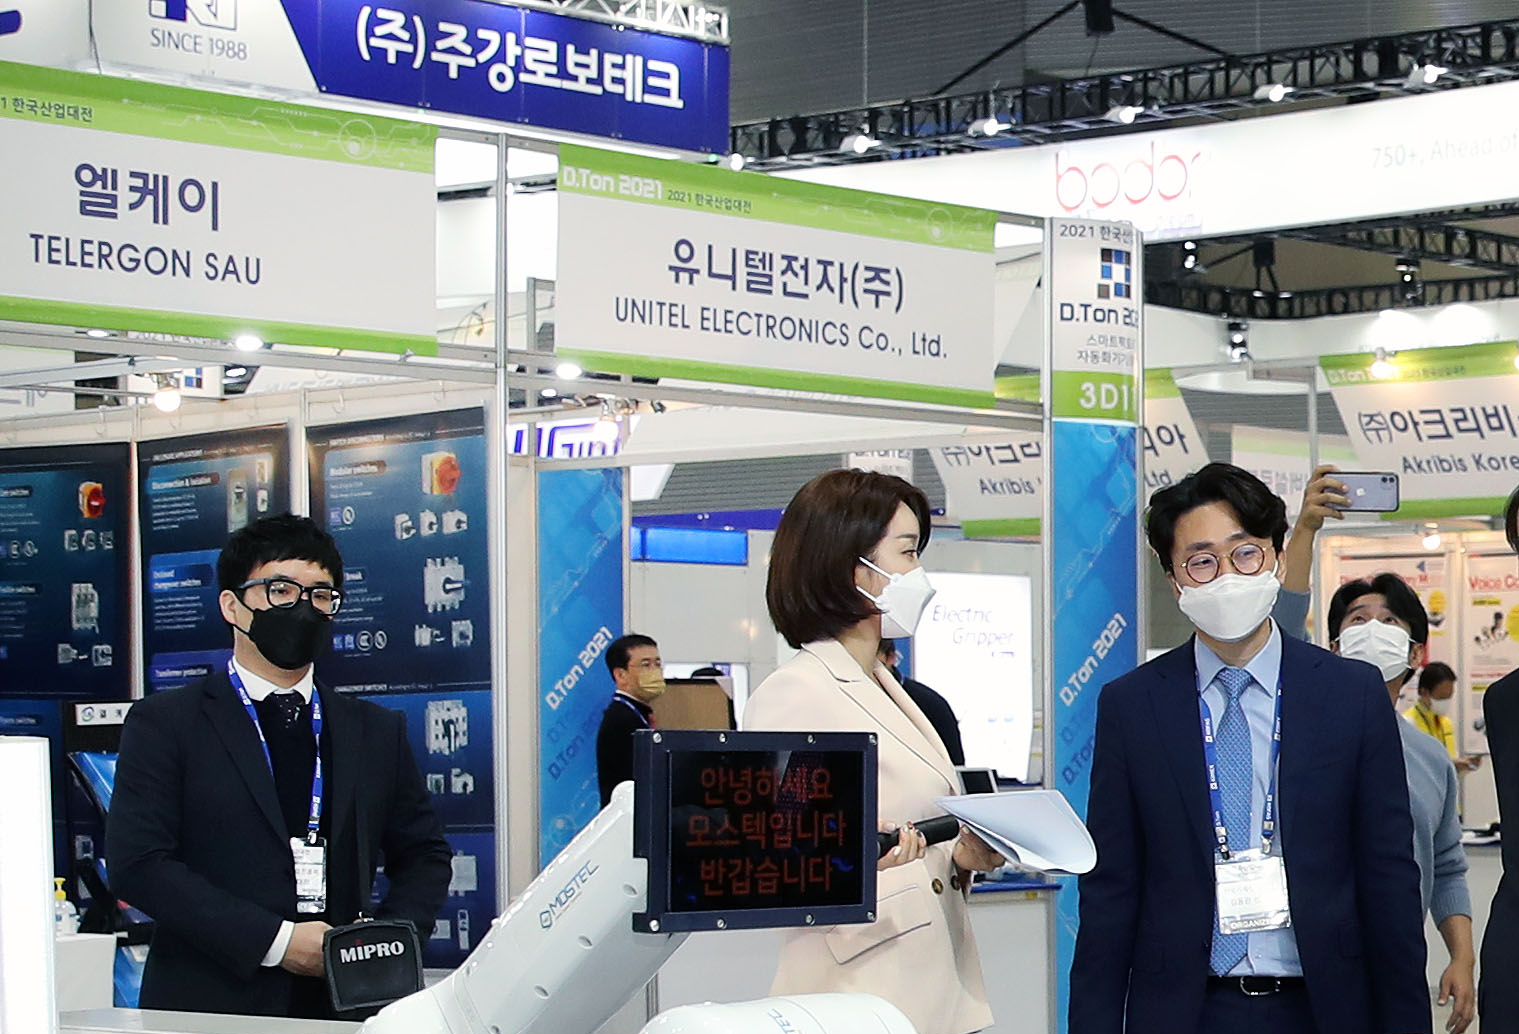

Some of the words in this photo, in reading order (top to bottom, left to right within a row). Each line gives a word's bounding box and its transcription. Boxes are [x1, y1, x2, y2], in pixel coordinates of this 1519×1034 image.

[150, 28, 203, 55] SINCE
[208, 37, 248, 61] 1988
[356, 5, 685, 110] (주)주강로보테크
[12, 100, 94, 123] 한국산업대전
[74, 162, 220, 232] 엘케이
[562, 167, 615, 194] D.Ton
[619, 177, 663, 200] 2021
[667, 188, 693, 204] 2021
[695, 192, 752, 214] 한국산업대전
[1060, 224, 1094, 238] 2021
[29, 233, 192, 279] TELERGON
[204, 251, 263, 285] SAU
[667, 238, 905, 314] 유니텔전자(주)
[614, 296, 691, 330] UNITEL
[700, 306, 849, 348] ELECTRONICS
[858, 325, 903, 357] Co.,
[912, 331, 948, 359] Ltd.
[1059, 302, 1119, 325] D.Ton
[1402, 452, 1468, 476] Akribis
[979, 477, 1036, 496] Akribis
[545, 665, 585, 710] D.Ton
[578, 625, 614, 669] 2021
[1059, 655, 1098, 707] D.Ton
[1092, 612, 1128, 660] 2021
[701, 766, 834, 806] 안녕하세요
[685, 810, 847, 849] 모스텍입니다
[548, 859, 600, 916] MOSTEC
[700, 854, 833, 896] 반갑습니다
